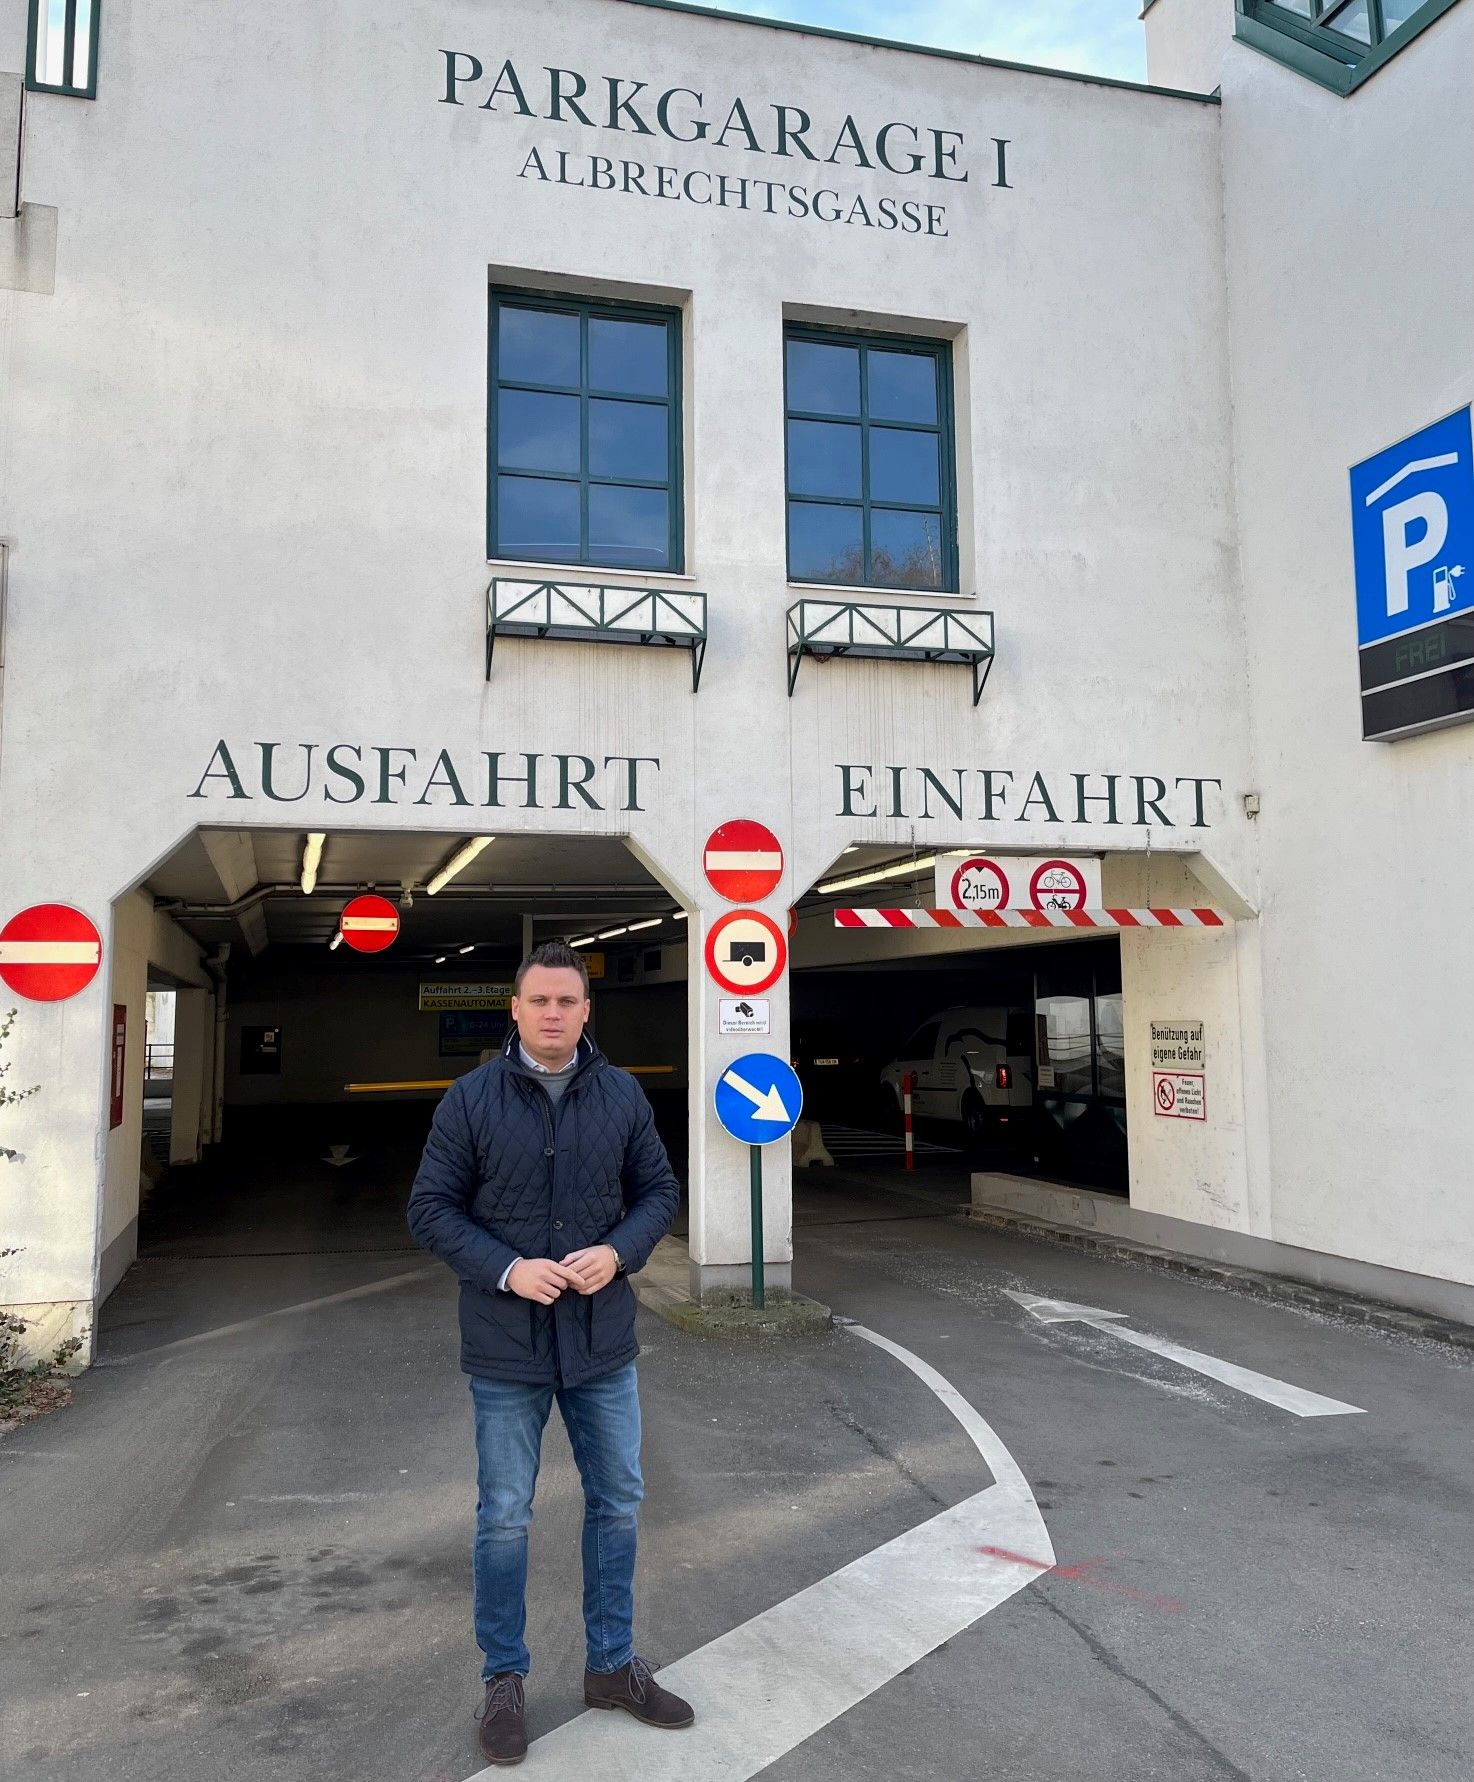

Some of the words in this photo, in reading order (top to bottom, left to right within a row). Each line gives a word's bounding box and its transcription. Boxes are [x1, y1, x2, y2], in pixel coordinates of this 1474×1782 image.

[437, 49, 970, 183] PARKGARAGE
[990, 137, 1015, 189] I
[516, 145, 950, 237] ALBRECHTSGASSE
[1382, 491, 1449, 617] P
[1396, 630, 1447, 673] FREI
[186, 738, 661, 812] AUSFAHRT
[834, 764, 1222, 828] EINFAHRT
[961, 877, 1000, 902] 2,15m
[423, 986, 461, 994] Auffahrt
[423, 999, 506, 1008] KASSENAUTOMAT
[1151, 1026, 1189, 1044] Benützung
[1190, 1027, 1202, 1041] auf
[1153, 1046, 1176, 1063] eigene
[1178, 1046, 1202, 1061] Gefahr
